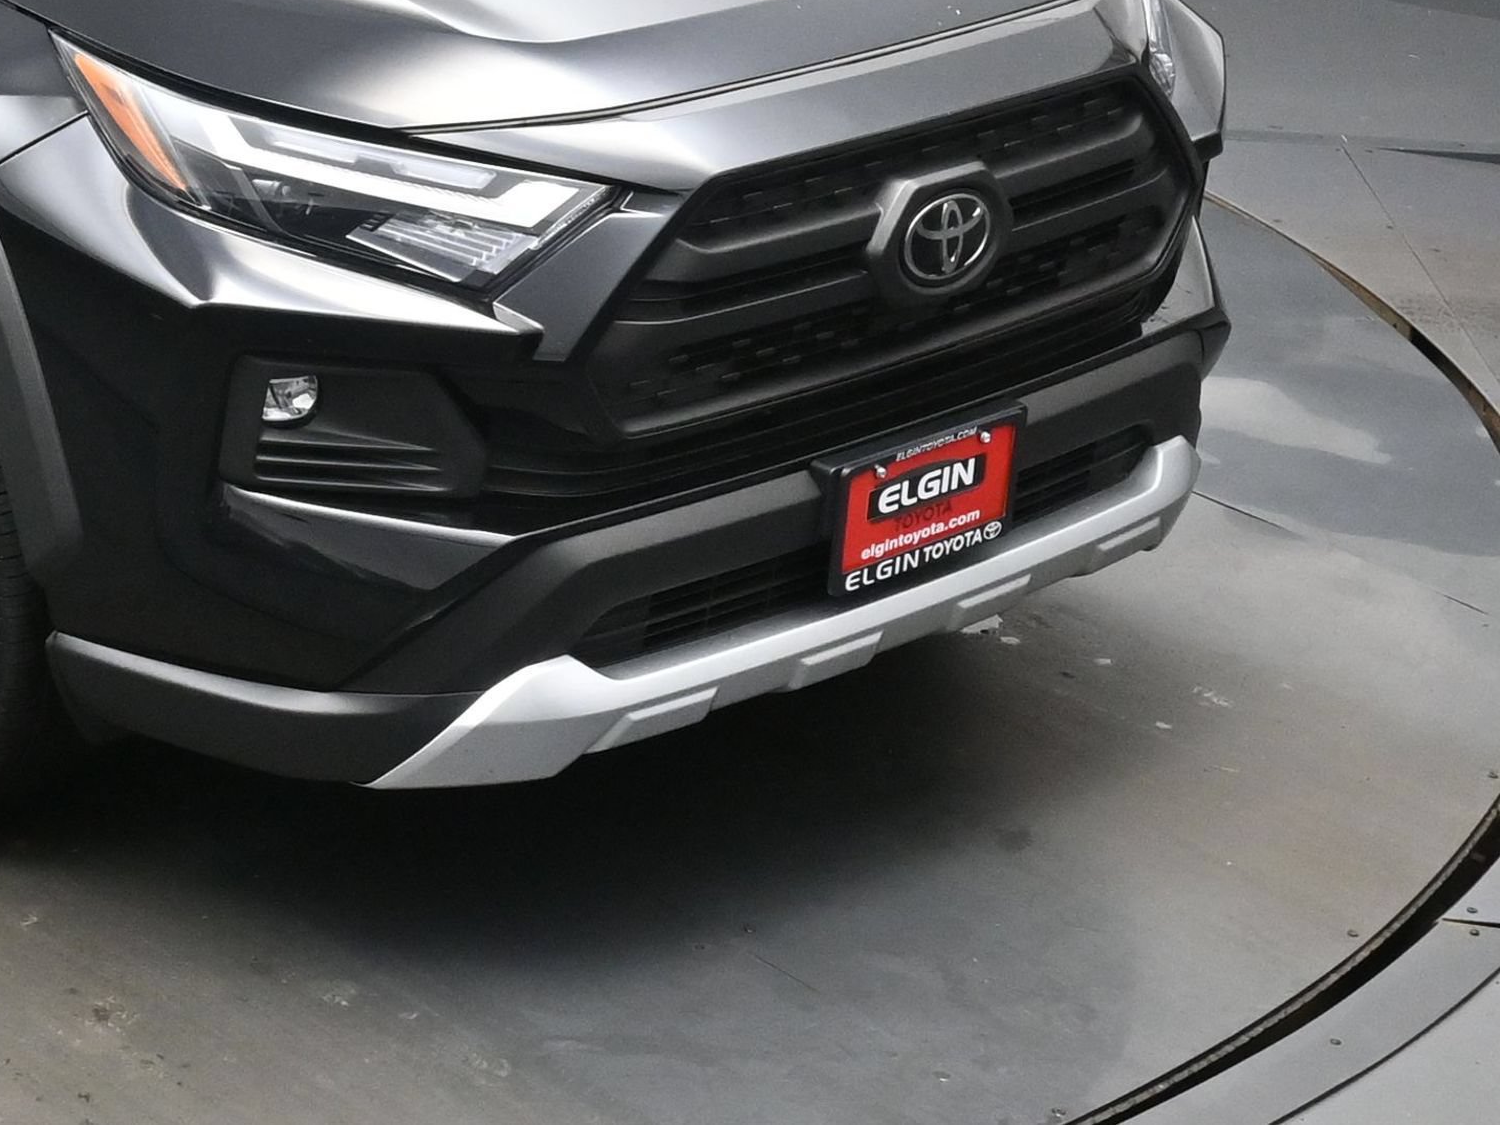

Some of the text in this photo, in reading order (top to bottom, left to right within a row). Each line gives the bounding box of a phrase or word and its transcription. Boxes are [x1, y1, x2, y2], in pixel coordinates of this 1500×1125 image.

[877, 458, 976, 514] ELGIN
[860, 509, 981, 560] elgintoyota.com
[894, 500, 954, 532] TOYOTA
[845, 528, 983, 592] ELGIN TOYOTA
